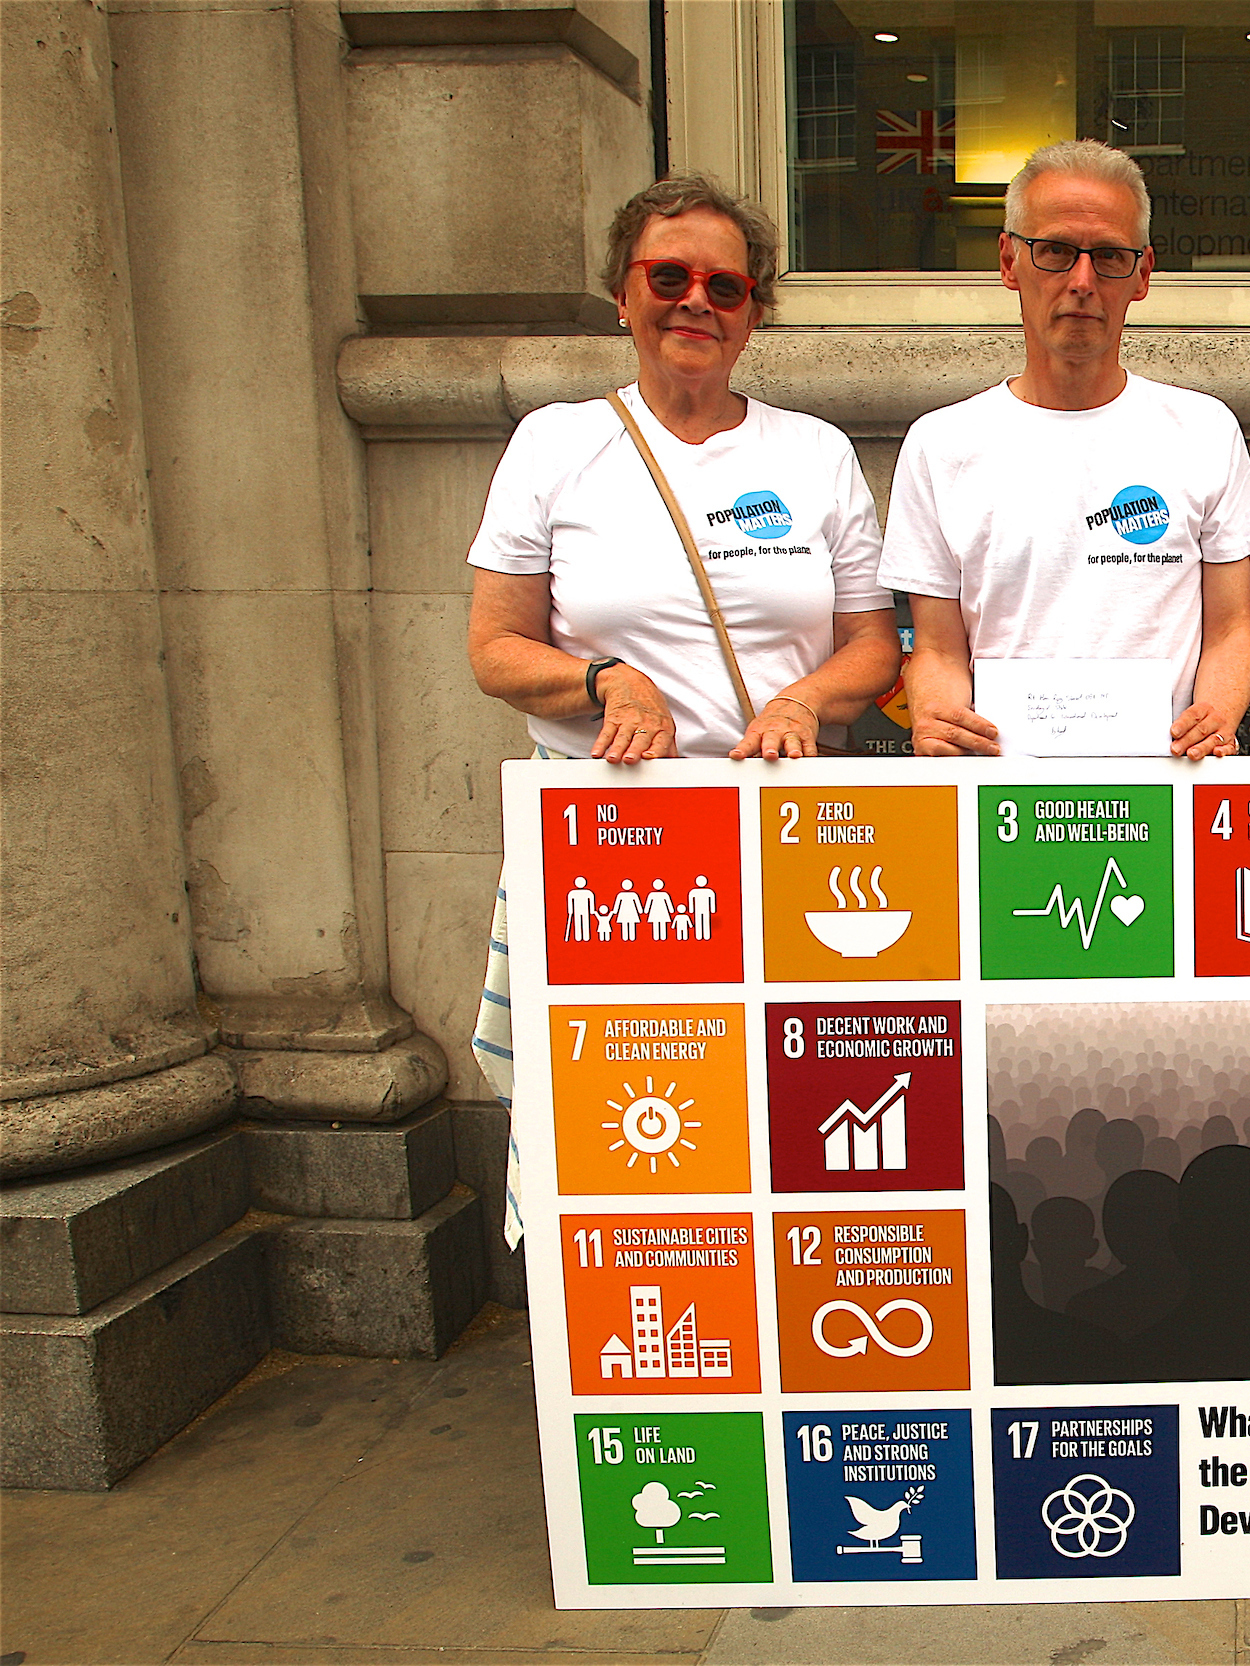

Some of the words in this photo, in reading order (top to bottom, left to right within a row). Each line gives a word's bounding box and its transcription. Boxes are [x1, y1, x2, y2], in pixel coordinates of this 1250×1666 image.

[706, 499, 781, 527] POPULATION
[738, 512, 793, 533] MATTERS
[1085, 496, 1160, 531] POPULATION
[1115, 508, 1170, 536] MATTERS
[708, 549, 721, 560] for
[723, 546, 757, 560] people,
[758, 545, 771, 555] for
[773, 546, 788, 555] the
[1087, 554, 1099, 565] for
[1101, 552, 1132, 565] people,
[1133, 552, 1146, 563] for
[1147, 552, 1161, 563] the
[1161, 552, 1184, 565] planet
[866, 740, 896, 754] THE
[563, 804, 578, 846] 1
[597, 804, 617, 823] NO
[780, 801, 800, 844] 2
[817, 802, 854, 821] ZERO
[997, 800, 1019, 842] 3
[1035, 800, 1075, 819] GOOD
[1077, 800, 1129, 819] HEALTH
[1211, 799, 1233, 840] 4
[597, 827, 663, 846] POVERTY
[817, 825, 875, 844] HUNGER
[1035, 823, 1065, 842] AND
[1067, 823, 1149, 842] WELL-BEING
[568, 1020, 587, 1061] 7
[604, 1019, 694, 1038] AFFORDABLE
[696, 1018, 726, 1037] AND
[783, 1017, 805, 1059] 8
[816, 1016, 870, 1036] DECENT
[872, 1016, 916, 1035] WORK
[917, 1016, 947, 1034] AND
[817, 1039, 890, 1058] ECONOMIC
[892, 1038, 953, 1057] GROWTH
[605, 1042, 650, 1061] CLEAN
[652, 1041, 706, 1060] ENERGY
[573, 1229, 603, 1268] 11
[613, 1227, 704, 1246] SUSTAINABLE
[705, 1227, 748, 1245] CITIES
[787, 1226, 822, 1265] 12
[834, 1224, 924, 1243] RESPONSIBLE
[615, 1250, 644, 1268] AND
[645, 1249, 738, 1267] COMMUNITIES
[835, 1246, 932, 1265] CONSUMPTION
[836, 1269, 865, 1287] AND
[866, 1267, 952, 1286] PRODUCTION
[588, 1427, 624, 1465] 15
[634, 1426, 661, 1443] LIFE
[797, 1424, 833, 1462] 16
[841, 1423, 890, 1441] PEACE,
[892, 1422, 949, 1440] JUSTICE
[1007, 1421, 1039, 1459] 17
[1051, 1418, 1153, 1438] PARTNERSHIPS
[1052, 1441, 1079, 1458] FOR
[1080, 1440, 1106, 1457] THE
[1108, 1439, 1152, 1457] GOALS
[635, 1447, 656, 1464] ON
[659, 1447, 696, 1464] LAND
[843, 1444, 872, 1462] AND
[874, 1443, 929, 1461] STRONG
[844, 1464, 936, 1482] INSTITUTIONS
[1198, 1456, 1248, 1488] the
